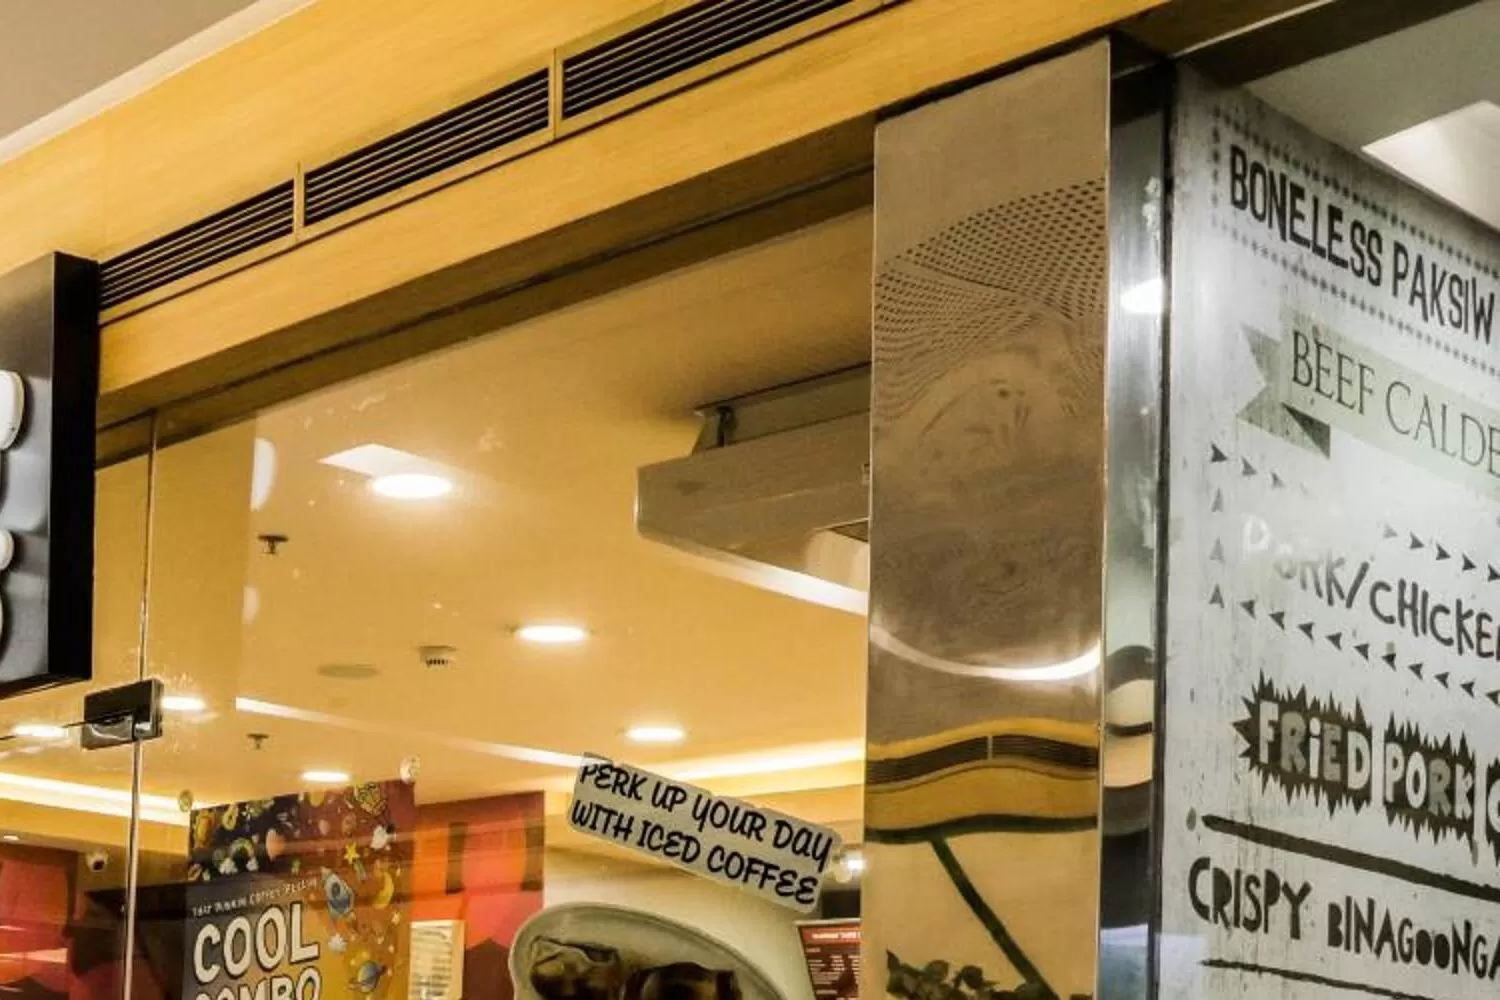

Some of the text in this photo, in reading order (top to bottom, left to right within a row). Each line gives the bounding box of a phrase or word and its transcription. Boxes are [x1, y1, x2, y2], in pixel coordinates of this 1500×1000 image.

[1229, 142, 1496, 345] BONELESS PAKSIW
[1291, 329, 1376, 416] BEEF
[1244, 515, 1500, 661] PORK/CHICKE
[579, 763, 834, 873] PERK UP YOUR DAY
[1384, 742, 1474, 820] PORK
[570, 799, 819, 905] WITH ICED COFFEE
[1188, 856, 1312, 941] CRISPY
[193, 902, 320, 984] COOL
